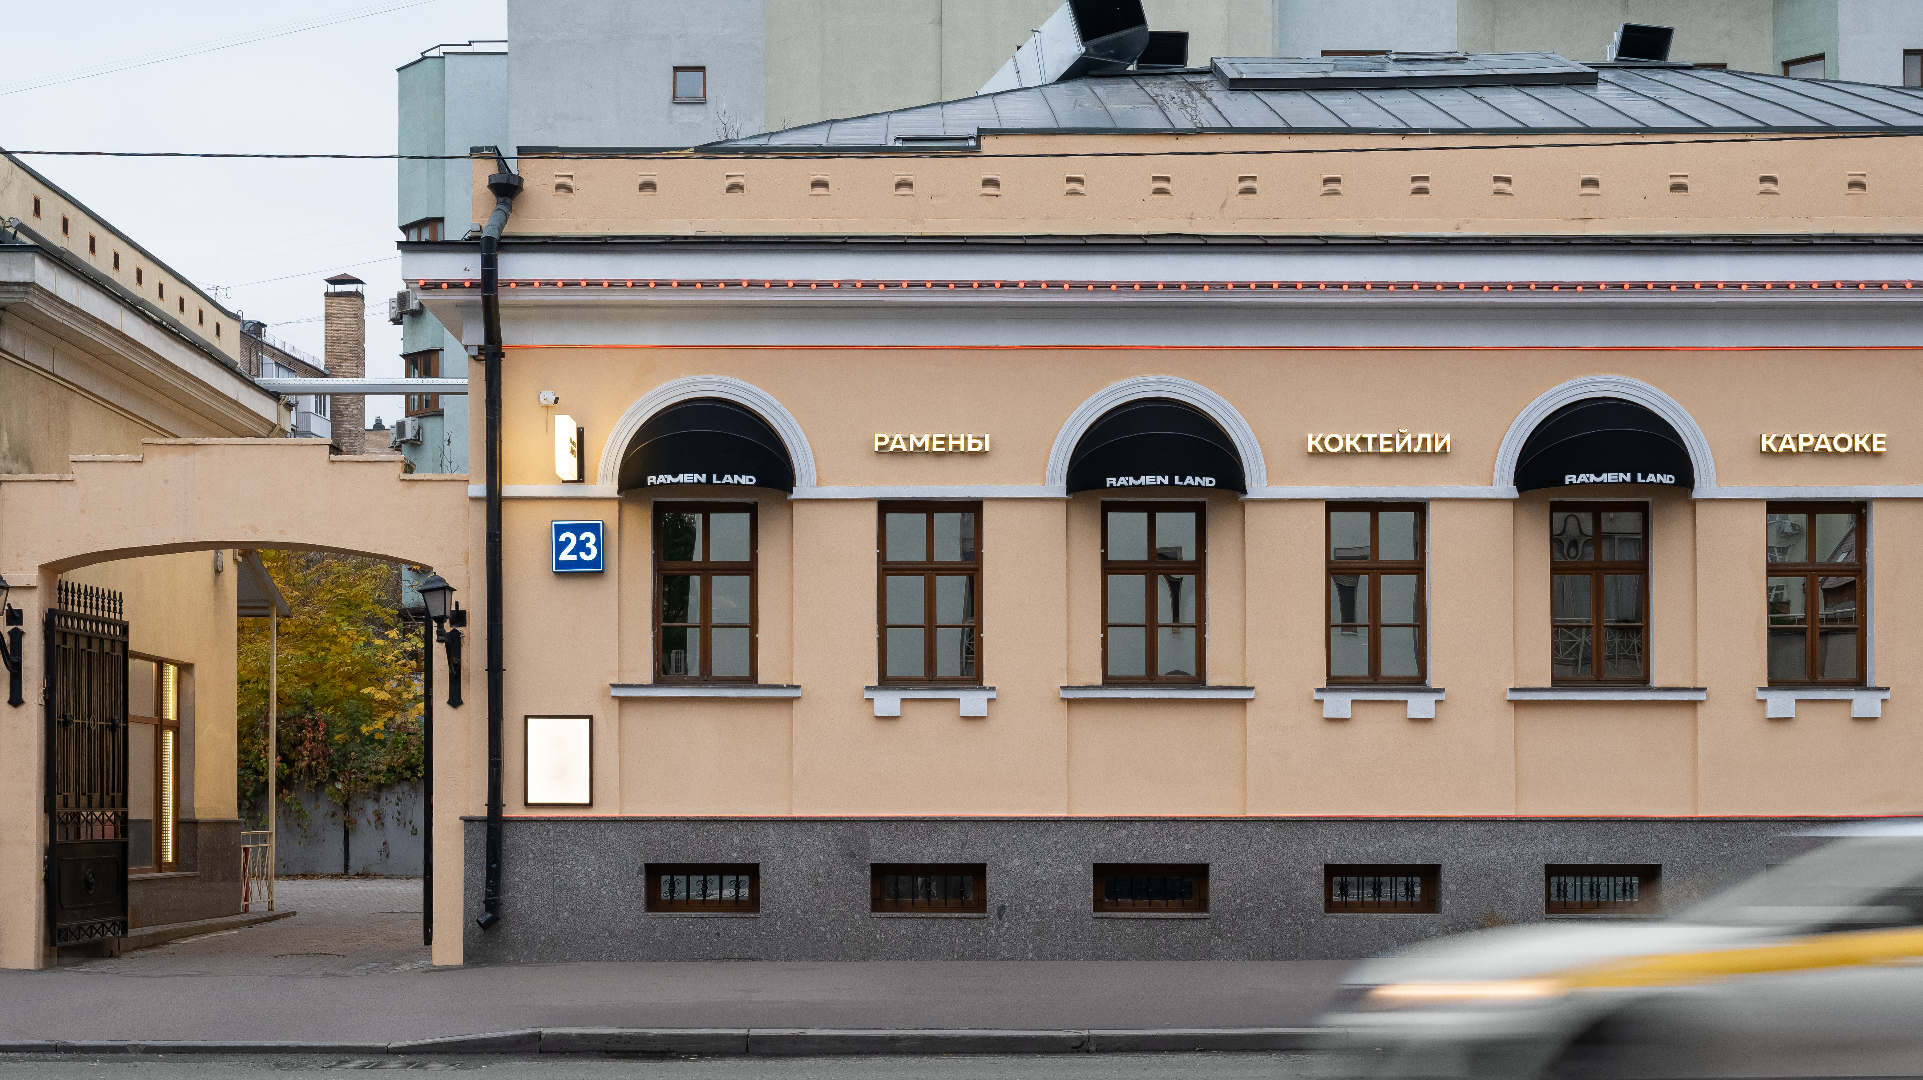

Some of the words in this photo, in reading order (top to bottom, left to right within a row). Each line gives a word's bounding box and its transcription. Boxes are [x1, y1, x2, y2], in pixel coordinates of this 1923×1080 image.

[874, 433, 990, 452] РАМЕНЫ
[1307, 428, 1451, 453] КОКТЕЙЛИ
[1760, 433, 1887, 452] КАРАОКЕ
[712, 473, 757, 485] LAND
[1174, 475, 1216, 487] LAND
[1637, 472, 1676, 484] LAND
[558, 531, 598, 561] 23
